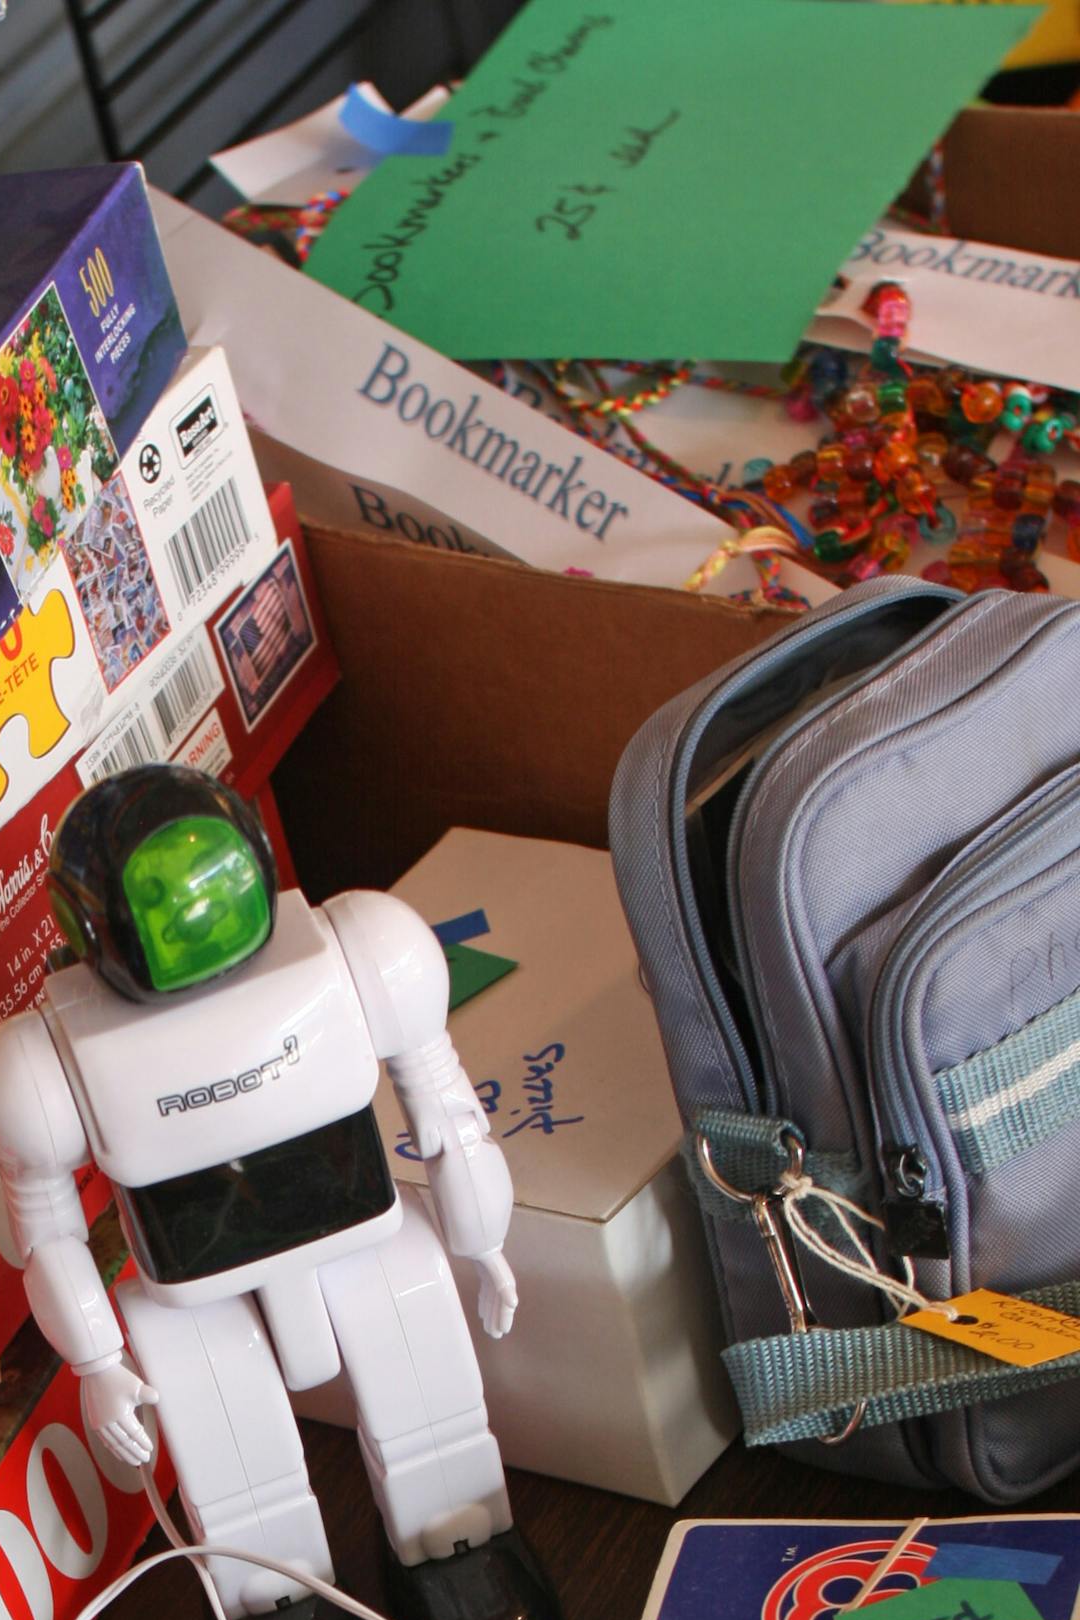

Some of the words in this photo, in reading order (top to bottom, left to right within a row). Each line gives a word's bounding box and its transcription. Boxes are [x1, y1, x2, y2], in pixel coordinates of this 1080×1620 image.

[79, 247, 114, 318] 500
[94, 303, 136, 364] INTERLOCKING
[100, 303, 120, 334] FULLY
[110, 333, 131, 364] PIECES
[358, 342, 630, 543] Bookmarker
[34, 849, 44, 868] &
[0, 917, 11, 932] the
[9, 884, 37, 919] Collector
[6, 958, 21, 977] 14
[20, 945, 34, 963] in.
[32, 930, 41, 947] X
[28, 964, 41, 984] cm
